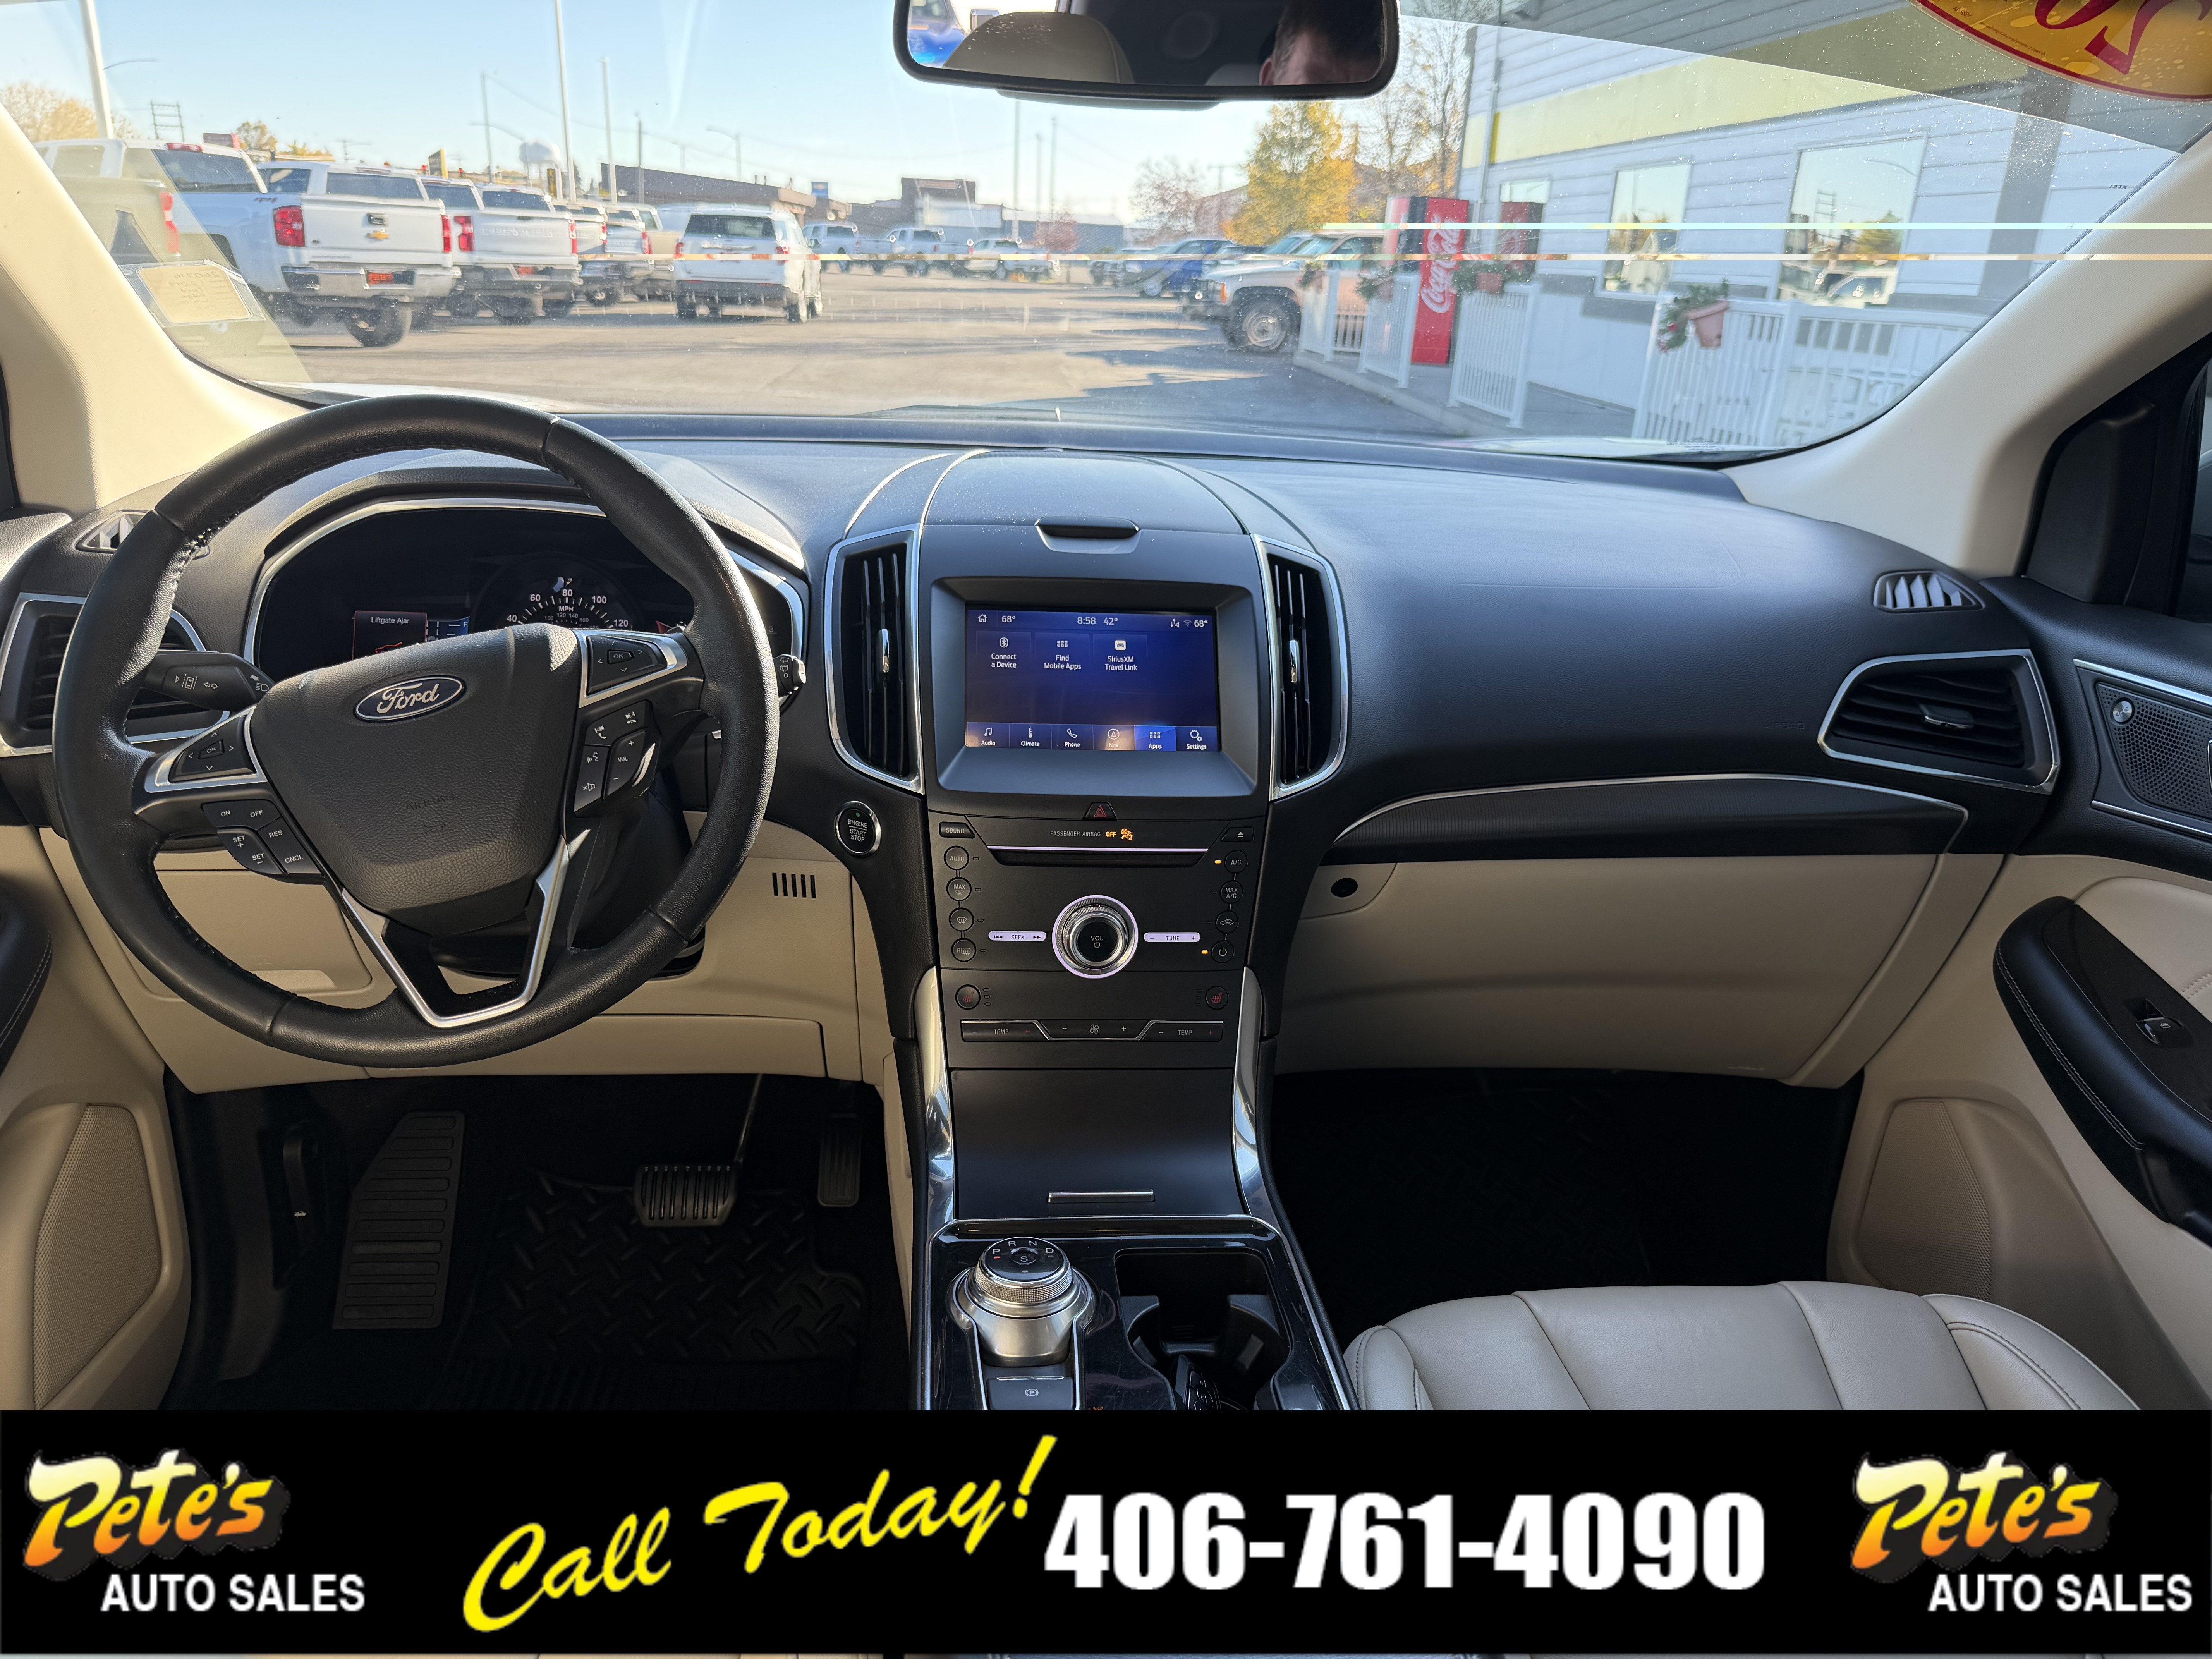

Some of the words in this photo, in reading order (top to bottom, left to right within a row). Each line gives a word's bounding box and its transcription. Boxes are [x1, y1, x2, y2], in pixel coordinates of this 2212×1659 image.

[530, 594, 541, 602] 60
[592, 596, 607, 604] 100
[614, 619, 629, 627] 120
[377, 682, 440, 713] Ford
[848, 819, 867, 828] ENGINE
[850, 828, 866, 836] START
[285, 855, 303, 864] CNCL
